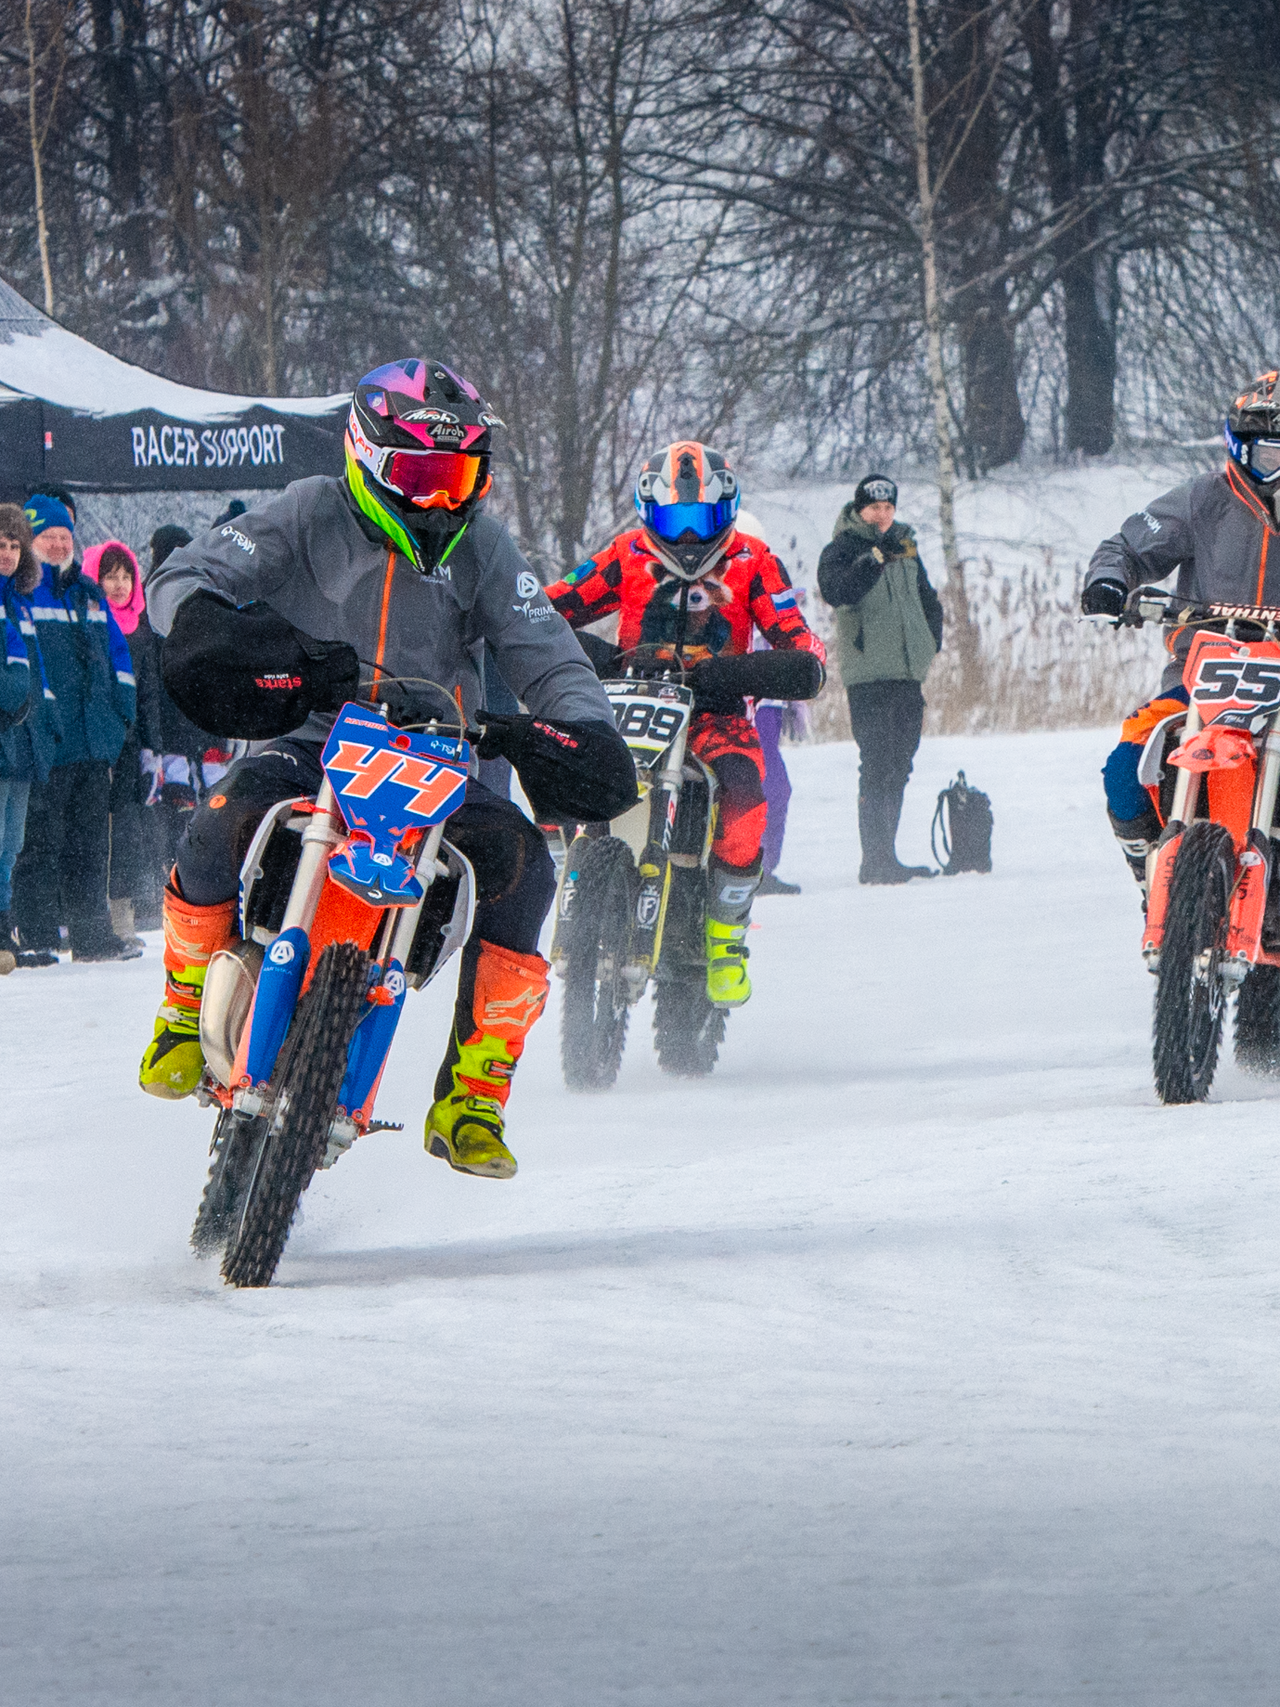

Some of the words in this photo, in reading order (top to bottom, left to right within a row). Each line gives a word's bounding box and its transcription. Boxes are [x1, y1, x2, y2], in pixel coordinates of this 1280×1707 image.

[405, 410, 451, 422] Airoh
[131, 424, 199, 466] RACER
[201, 423, 285, 467] SUPPORT
[430, 424, 465, 438] Airoh
[255, 676, 302, 690] starks
[611, 701, 684, 743] 89
[325, 740, 468, 818] 44
